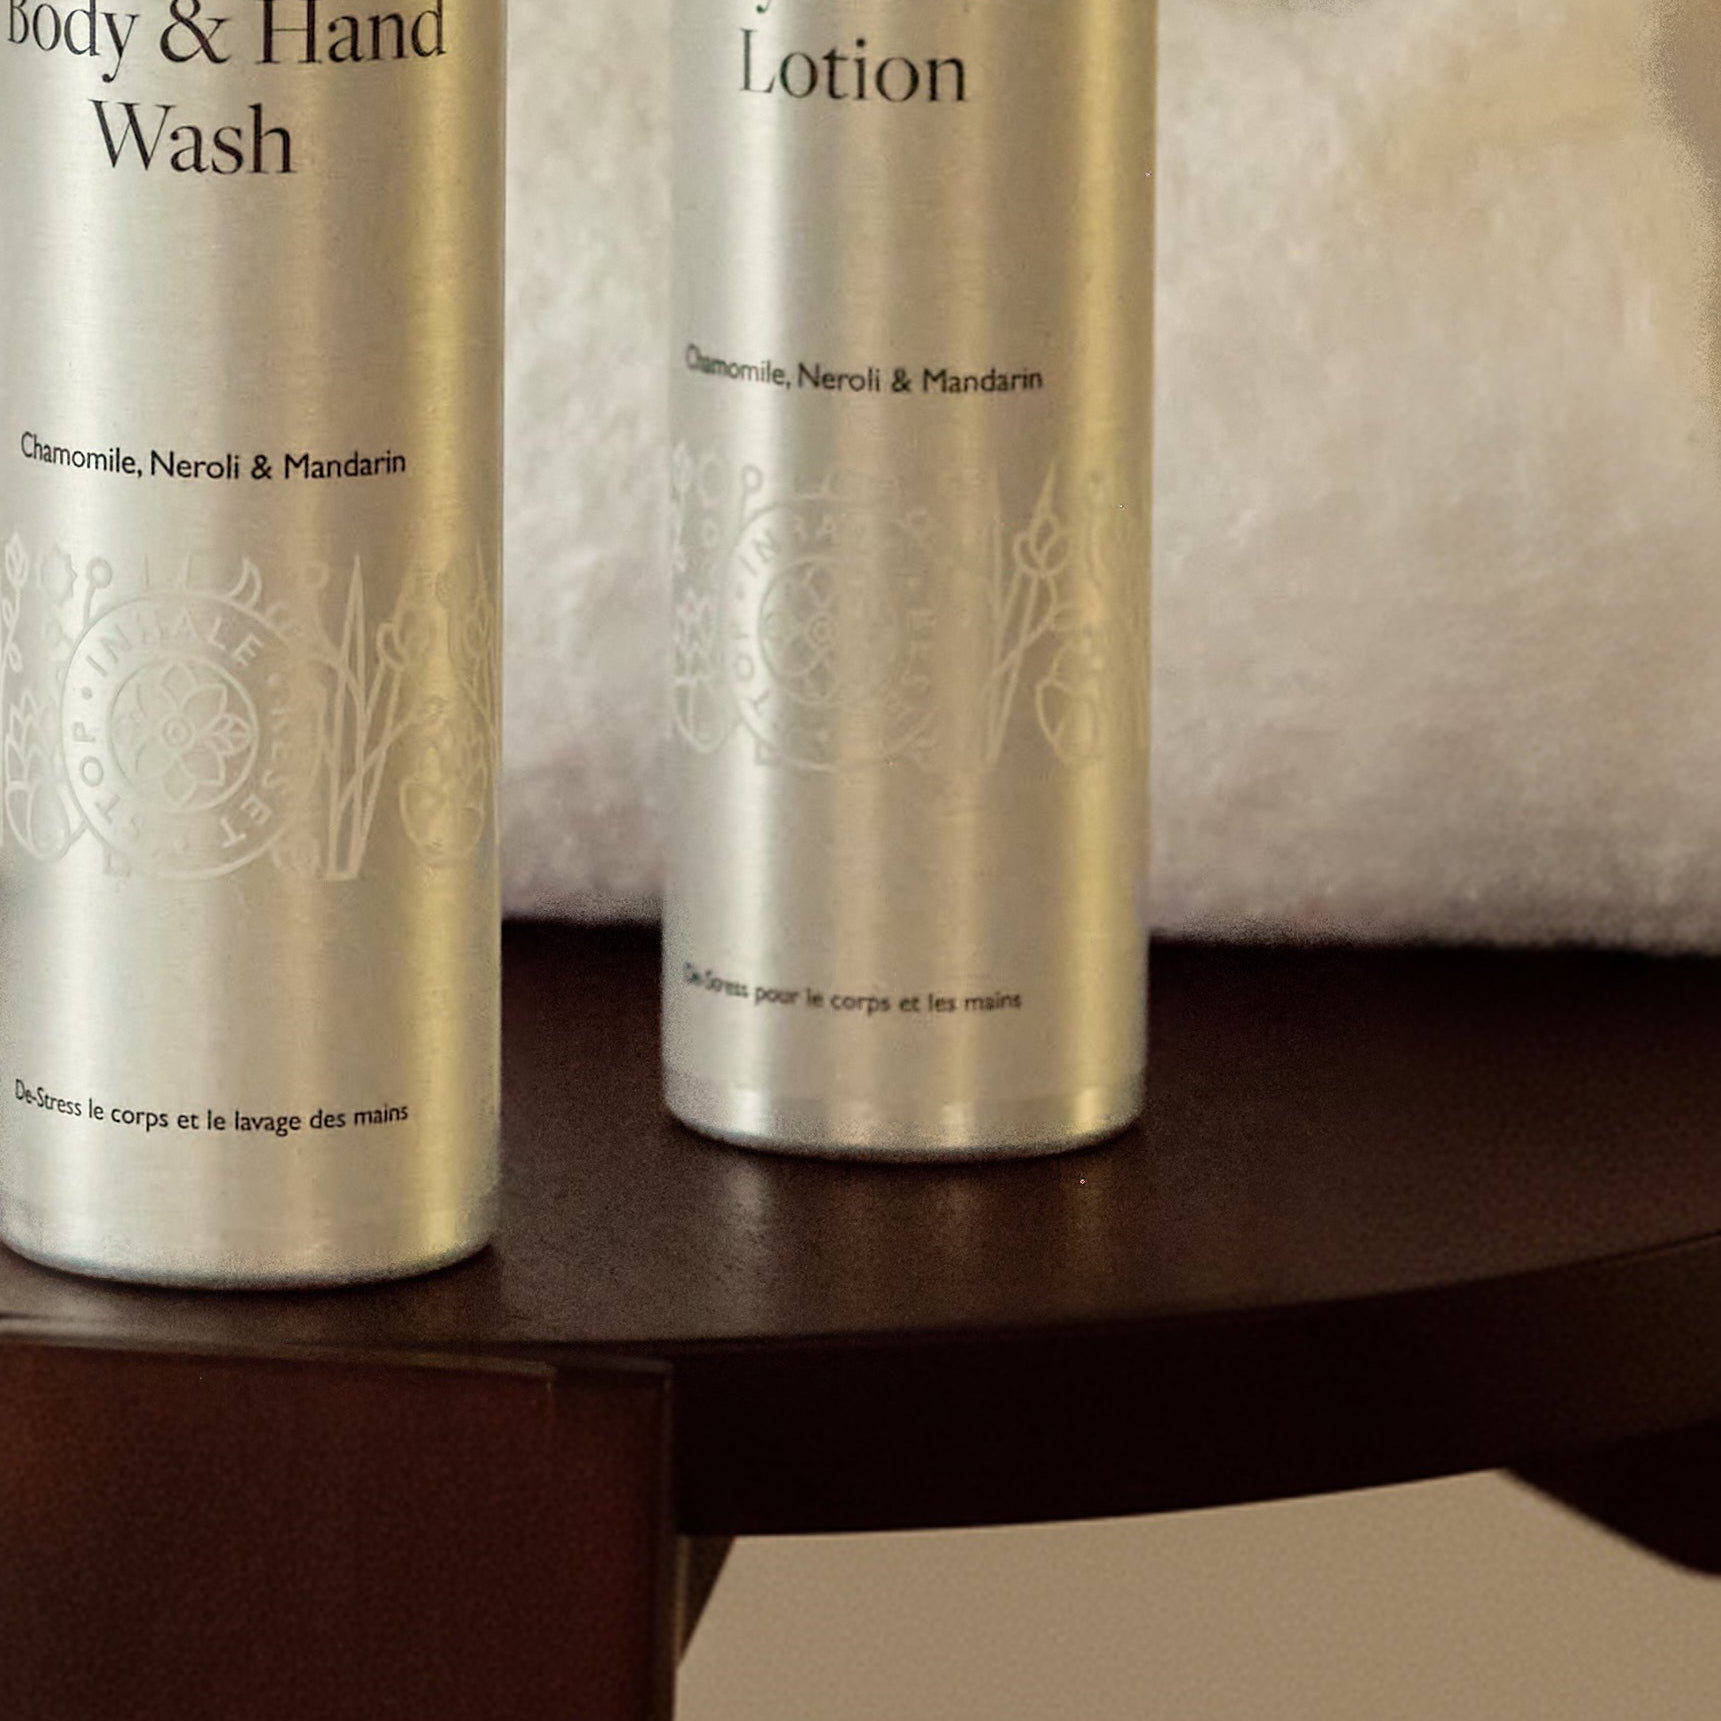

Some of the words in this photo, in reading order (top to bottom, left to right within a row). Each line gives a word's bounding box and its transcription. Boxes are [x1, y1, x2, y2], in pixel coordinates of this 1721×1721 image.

[740, 29, 969, 103] Lotion
[89, 99, 297, 174] Wash
[798, 363, 880, 392] Neroli
[892, 369, 912, 393] &
[923, 368, 1043, 394] Mandarin
[20, 431, 142, 478] Chamomile,
[151, 450, 240, 479] Neroli
[251, 455, 272, 479] &
[284, 450, 406, 480] Mandarin
[755, 986, 799, 1005] pour
[807, 988, 824, 1007] le
[831, 994, 891, 1015] corps
[900, 995, 920, 1012] et
[929, 993, 955, 1013] les
[965, 991, 1022, 1012] mains
[15, 1079, 81, 1116] De-Stress
[89, 1098, 103, 1120] le
[111, 1107, 168, 1131] corps
[178, 1111, 199, 1130] et
[208, 1110, 225, 1130] le
[236, 1111, 301, 1136] lavage
[310, 1109, 346, 1129] des
[354, 1104, 408, 1126] mains
